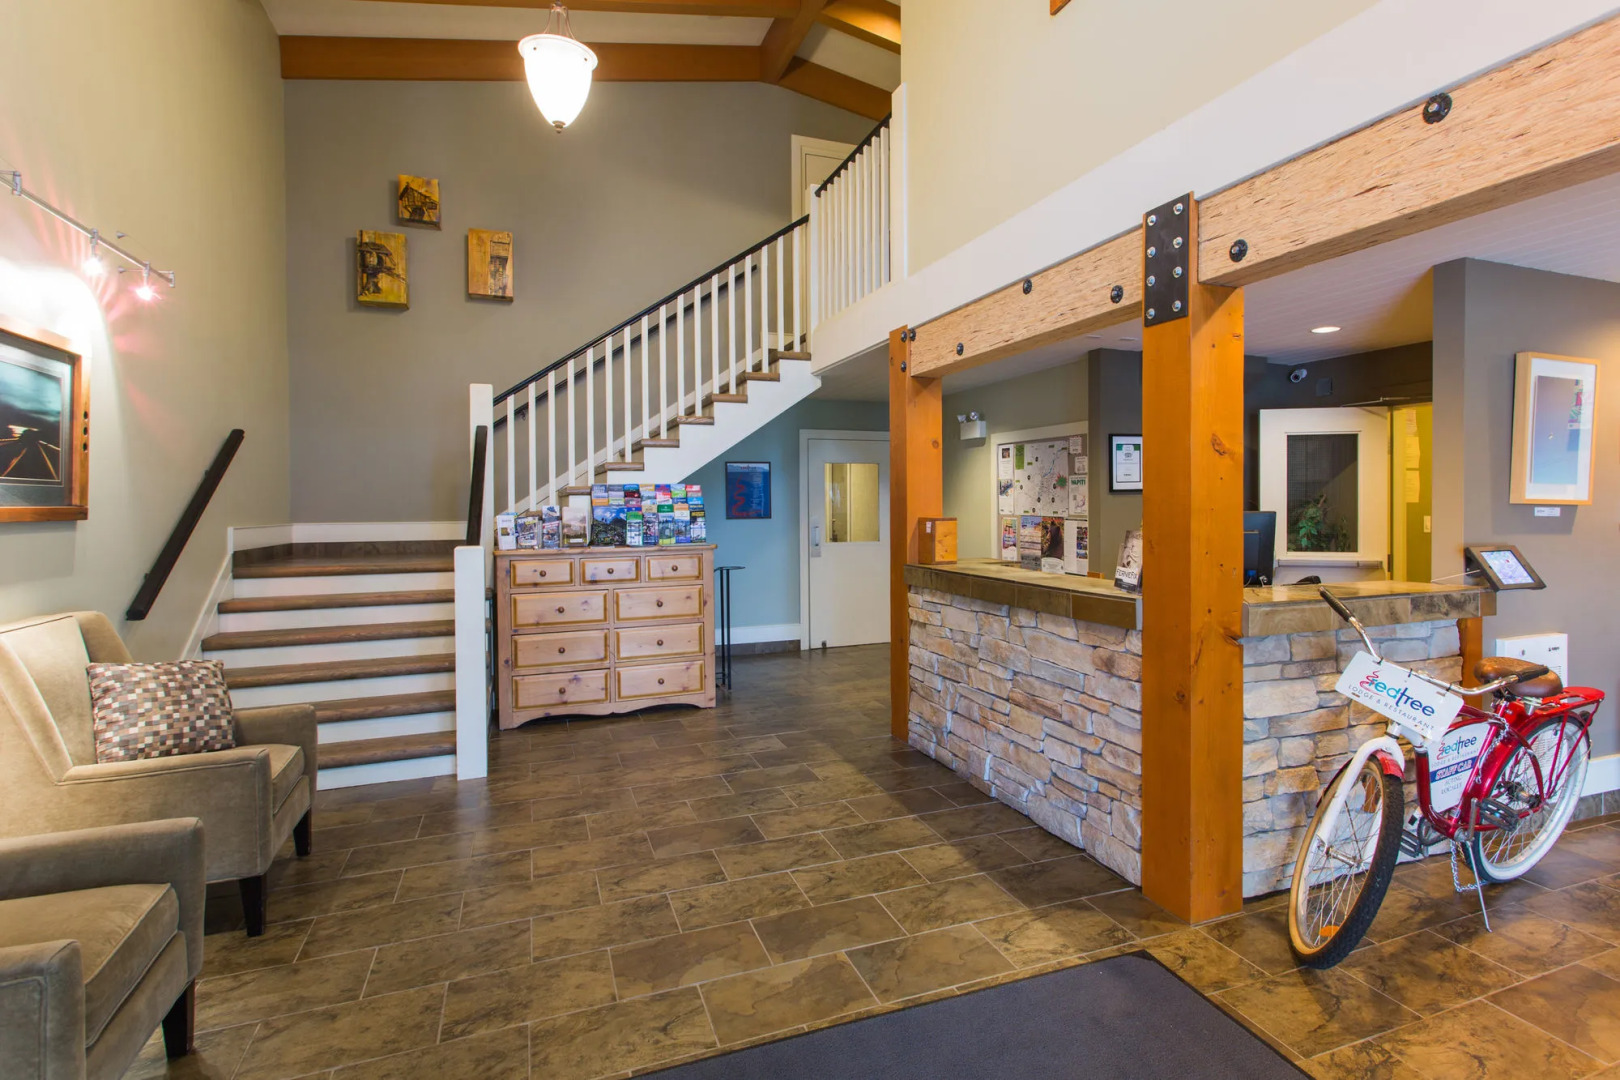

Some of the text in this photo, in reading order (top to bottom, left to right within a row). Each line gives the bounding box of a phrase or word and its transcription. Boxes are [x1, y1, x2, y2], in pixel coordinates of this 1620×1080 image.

[1348, 684, 1373, 701] LODGE
[1383, 702, 1435, 731] RESTAURANT
[1367, 678, 1435, 717] redtree
